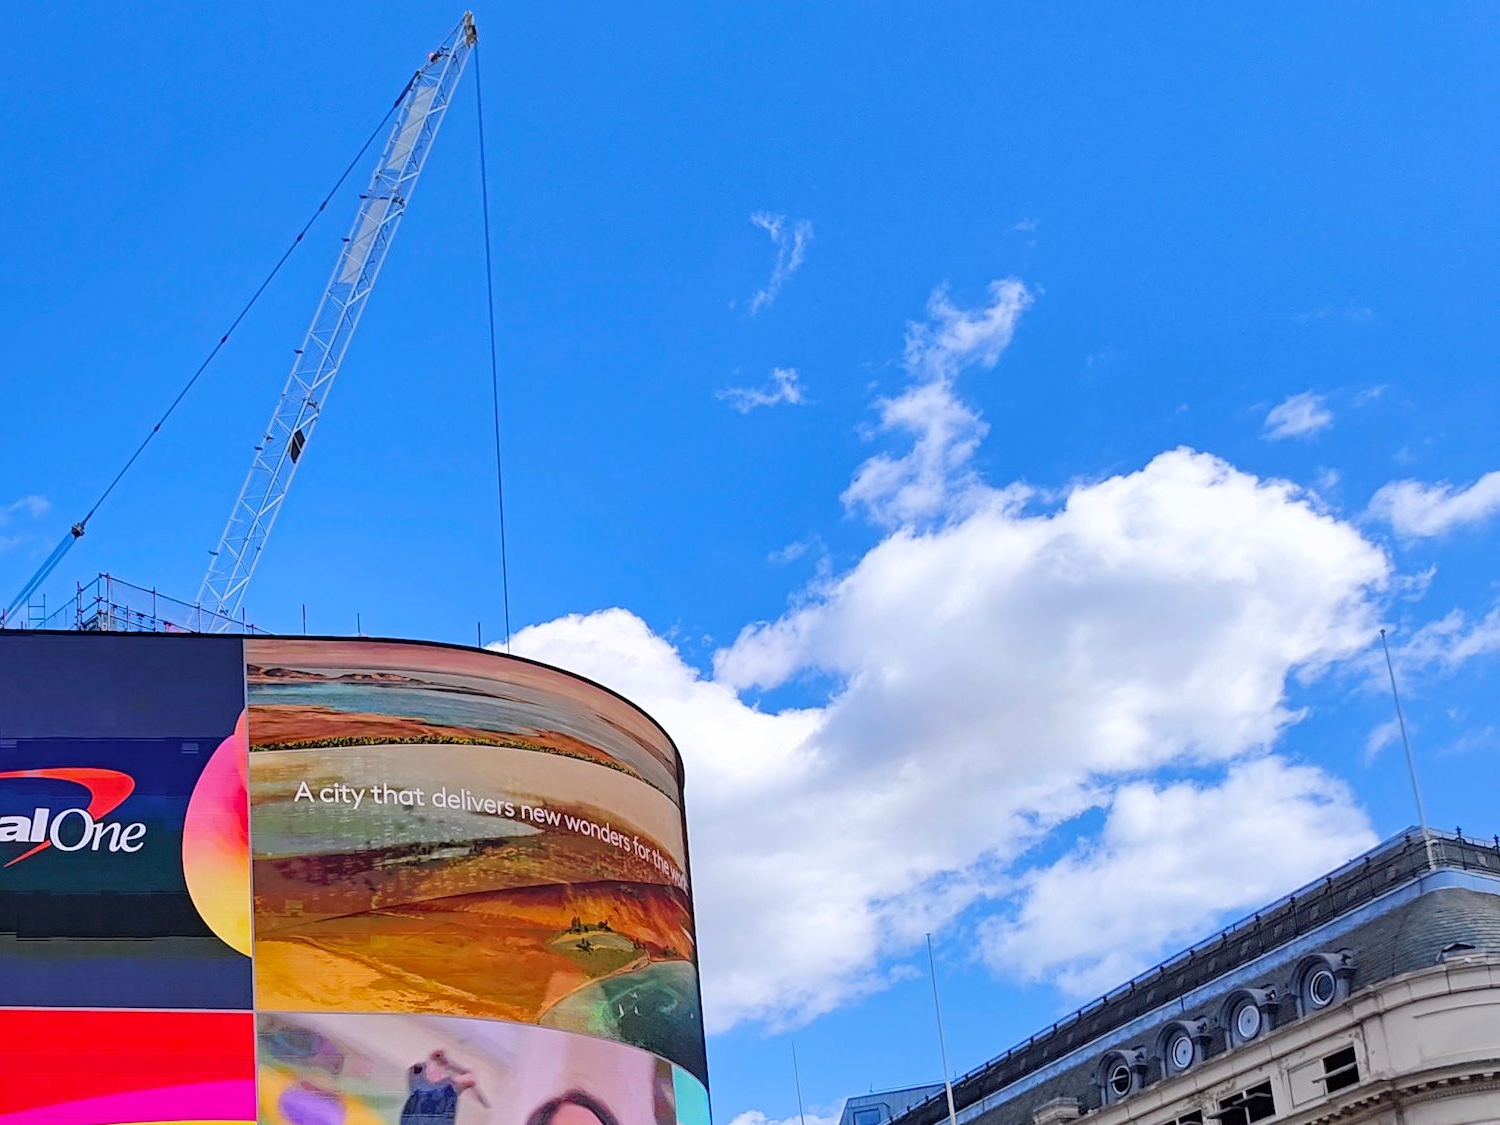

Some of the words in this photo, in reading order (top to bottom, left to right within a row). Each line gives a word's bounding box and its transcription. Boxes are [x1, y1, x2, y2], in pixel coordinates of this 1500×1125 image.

[293, 781, 315, 803] A
[319, 782, 365, 809] city
[370, 782, 425, 807] that
[431, 786, 515, 818] delivers
[520, 803, 561, 827] new
[564, 814, 631, 852] wonders
[632, 836, 651, 862] for
[652, 849, 670, 876] the
